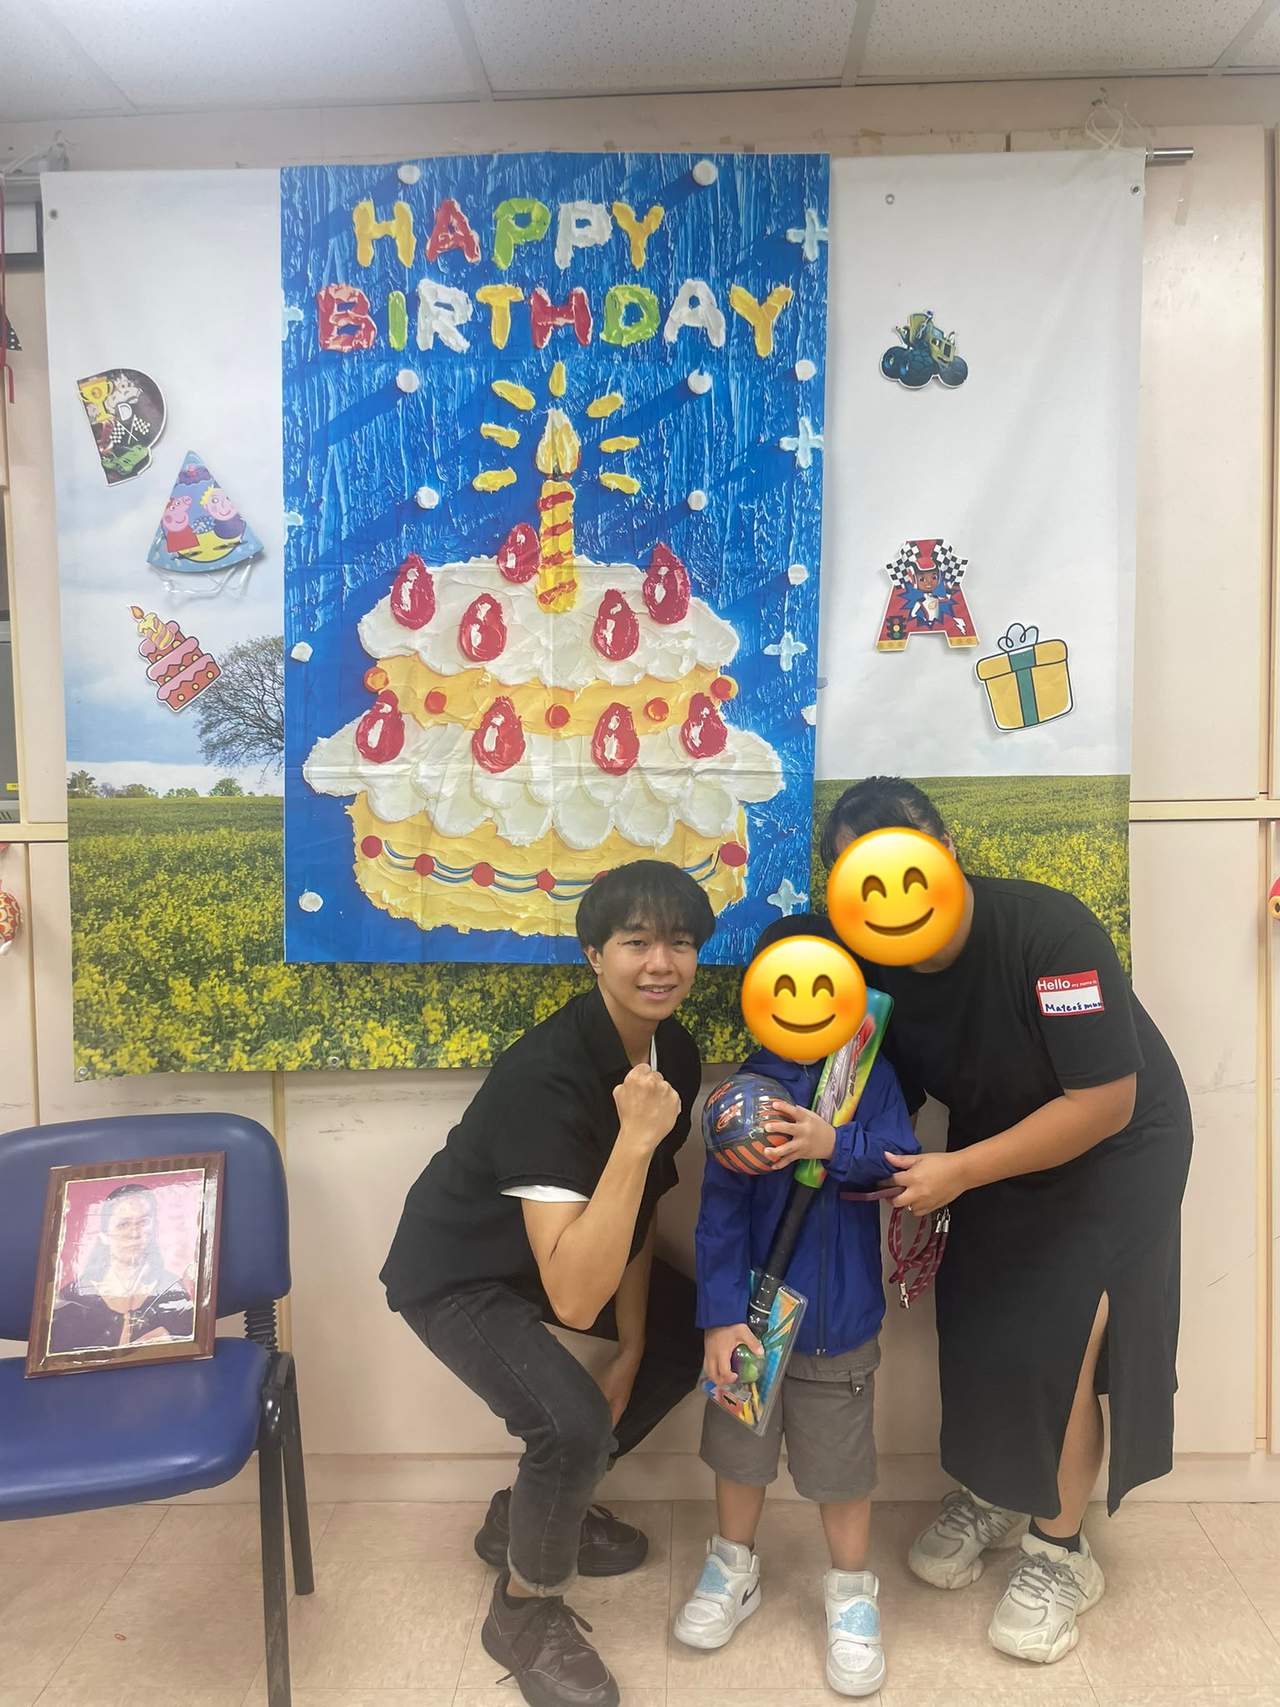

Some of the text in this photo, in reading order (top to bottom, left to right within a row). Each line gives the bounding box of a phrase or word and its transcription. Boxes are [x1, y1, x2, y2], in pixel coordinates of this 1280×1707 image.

[352, 199, 664, 269] HAPPY
[316, 278, 794, 358] BIRTHDAY
[1037, 978, 1070, 991] Hello
